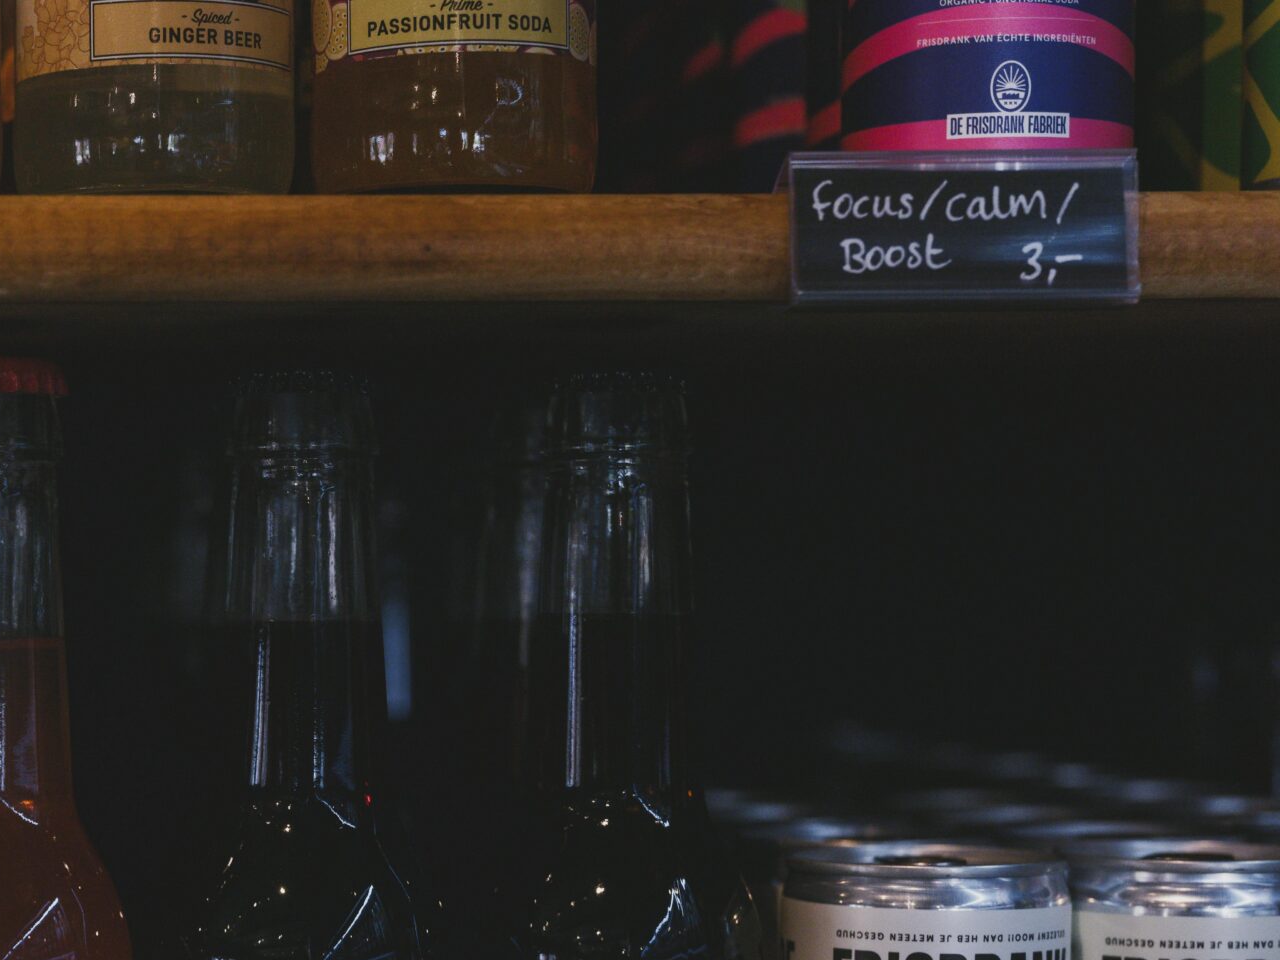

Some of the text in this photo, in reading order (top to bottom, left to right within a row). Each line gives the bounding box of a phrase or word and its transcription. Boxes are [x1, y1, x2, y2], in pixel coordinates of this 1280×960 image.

[191, 7, 232, 27] Spiced
[368, 13, 552, 37] PASSIONFRUIT SODA
[148, 26, 263, 50] GINGER BEER
[916, 31, 1096, 48] FRISDRANK VAN ÉCHTE INGREDIËNTEN
[950, 115, 1067, 136] DE FRISDRANK FABRIEK
[841, 233, 952, 274] Boost
